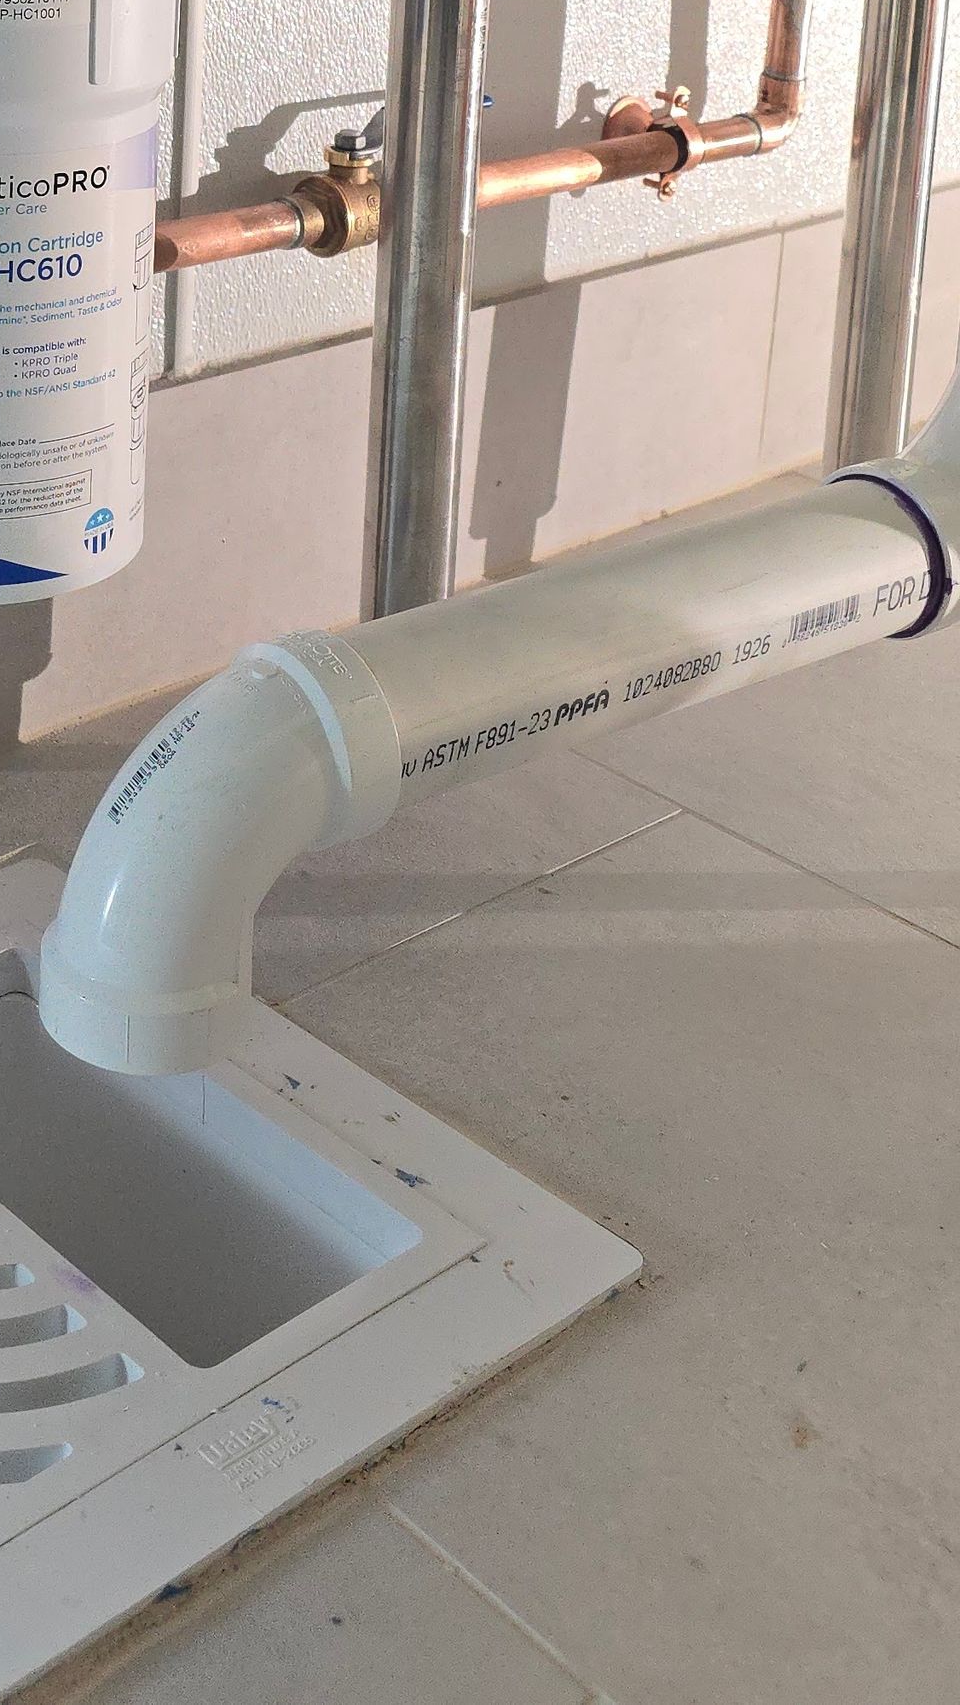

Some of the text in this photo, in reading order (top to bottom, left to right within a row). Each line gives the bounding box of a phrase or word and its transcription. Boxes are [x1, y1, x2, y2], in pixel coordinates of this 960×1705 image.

[15, 203, 48, 215] Care
[28, 231, 104, 252] Cartridge
[15, 299, 67, 312] mechanical
[69, 296, 85, 306] and
[86, 287, 117, 303] chemical
[78, 306, 98, 317] Taste
[106, 297, 123, 309] Odor
[2, 346, 10, 355] is
[12, 342, 65, 355] compatible
[67, 337, 87, 348] with:
[21, 352, 79, 368] KPRO Triple
[21, 364, 77, 380] KPRO Quad
[6, 389, 21, 398] the
[25, 382, 71, 397] NSF/ANSI
[73, 372, 107, 389] Standard
[18, 438, 37, 446] Date
[42, 444, 68, 455] unsafe
[78, 439, 86, 447] of
[13, 459, 41, 469] before
[53, 455, 70, 464] after
[72, 451, 83, 459] the
[6, 488, 21, 496] NSF
[22, 483, 64, 495] International
[20, 496, 32, 504] the
[33, 491, 65, 502] reduction
[65, 489, 73, 497] of
[4, 503, 49, 514] performance
[49, 500, 64, 508] data
[873, 576, 916, 617] FOR
[422, 735, 471, 772] ASTM
[475, 709, 551, 754] F891-23
[553, 689, 610, 726] PPFA
[623, 651, 722, 702] 1024082B80
[732, 634, 771, 665] 1926
